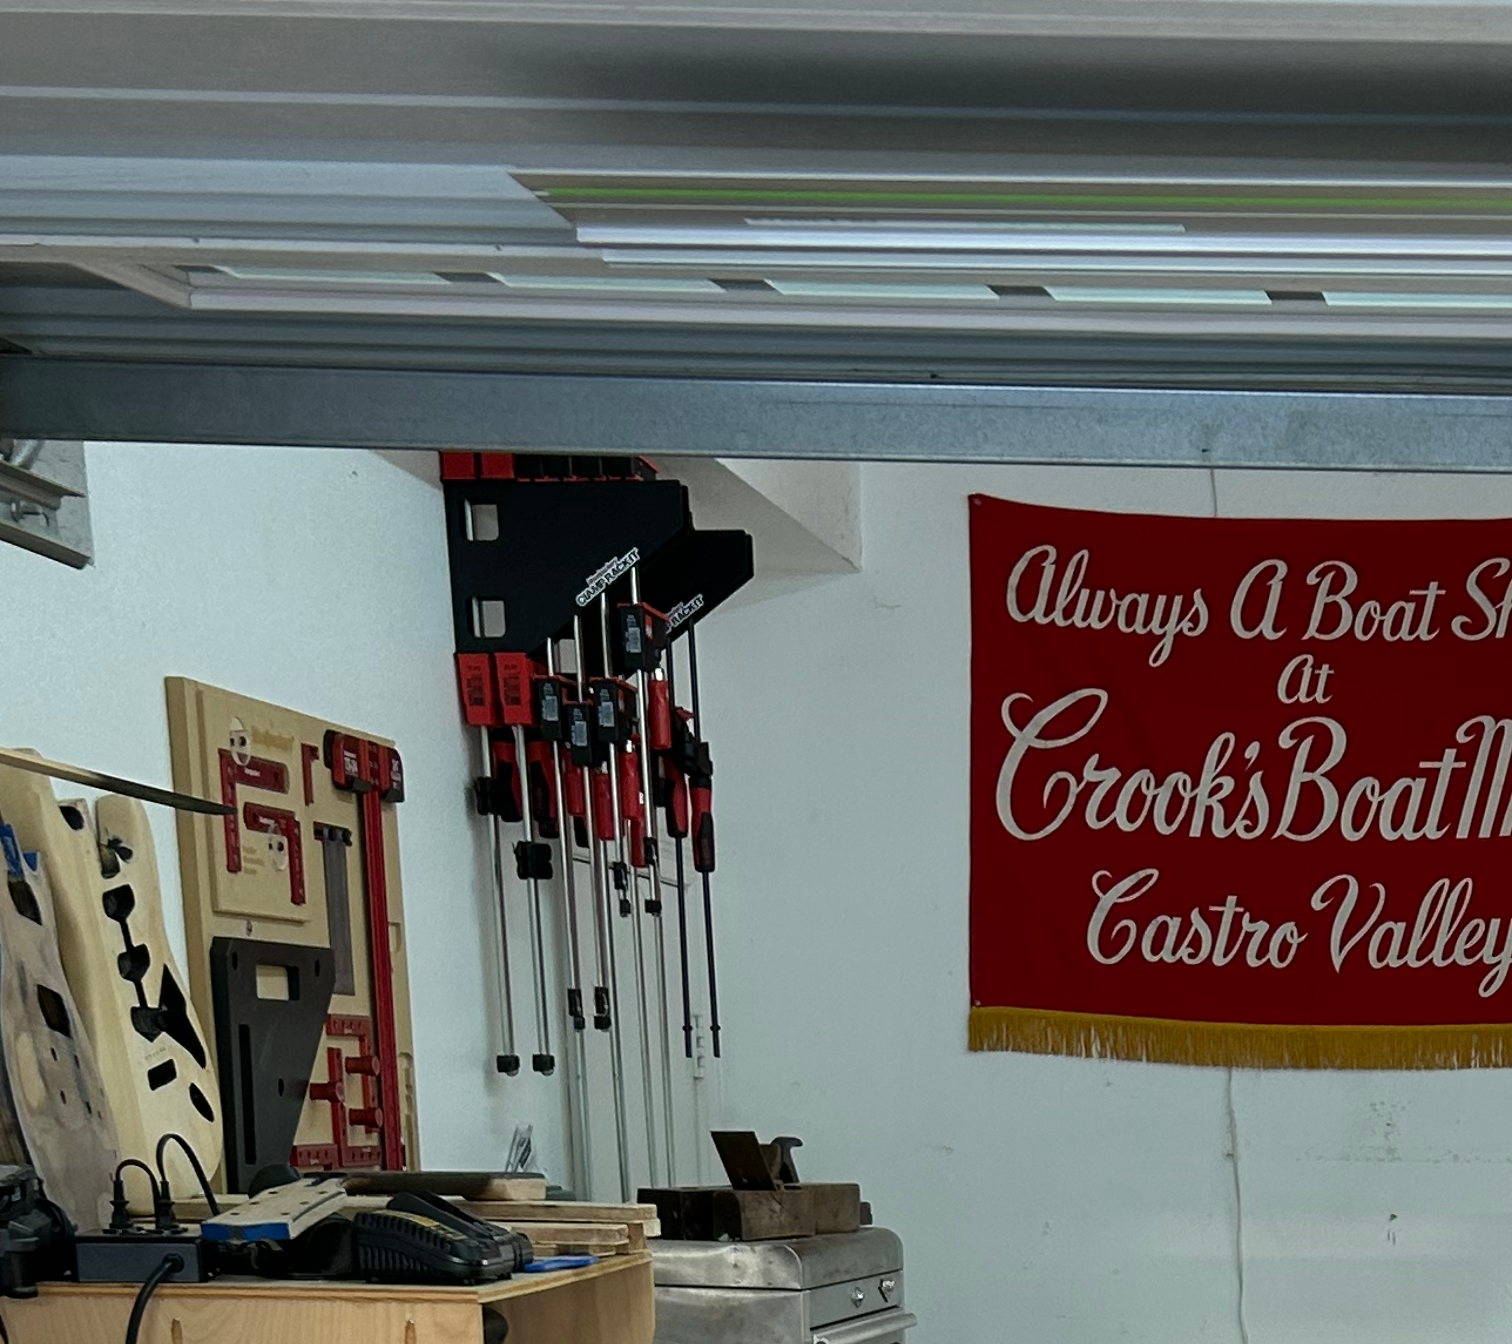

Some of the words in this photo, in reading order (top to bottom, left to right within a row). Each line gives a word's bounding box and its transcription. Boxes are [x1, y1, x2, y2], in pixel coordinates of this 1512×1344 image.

[1007, 545, 1208, 667] Always
[1231, 560, 1287, 640] A
[1302, 561, 1446, 642] Boat
[1278, 655, 1335, 704] At
[996, 688, 1272, 841] Crook's
[1272, 716, 1467, 842] Boat
[1087, 868, 1308, 969] Castro
